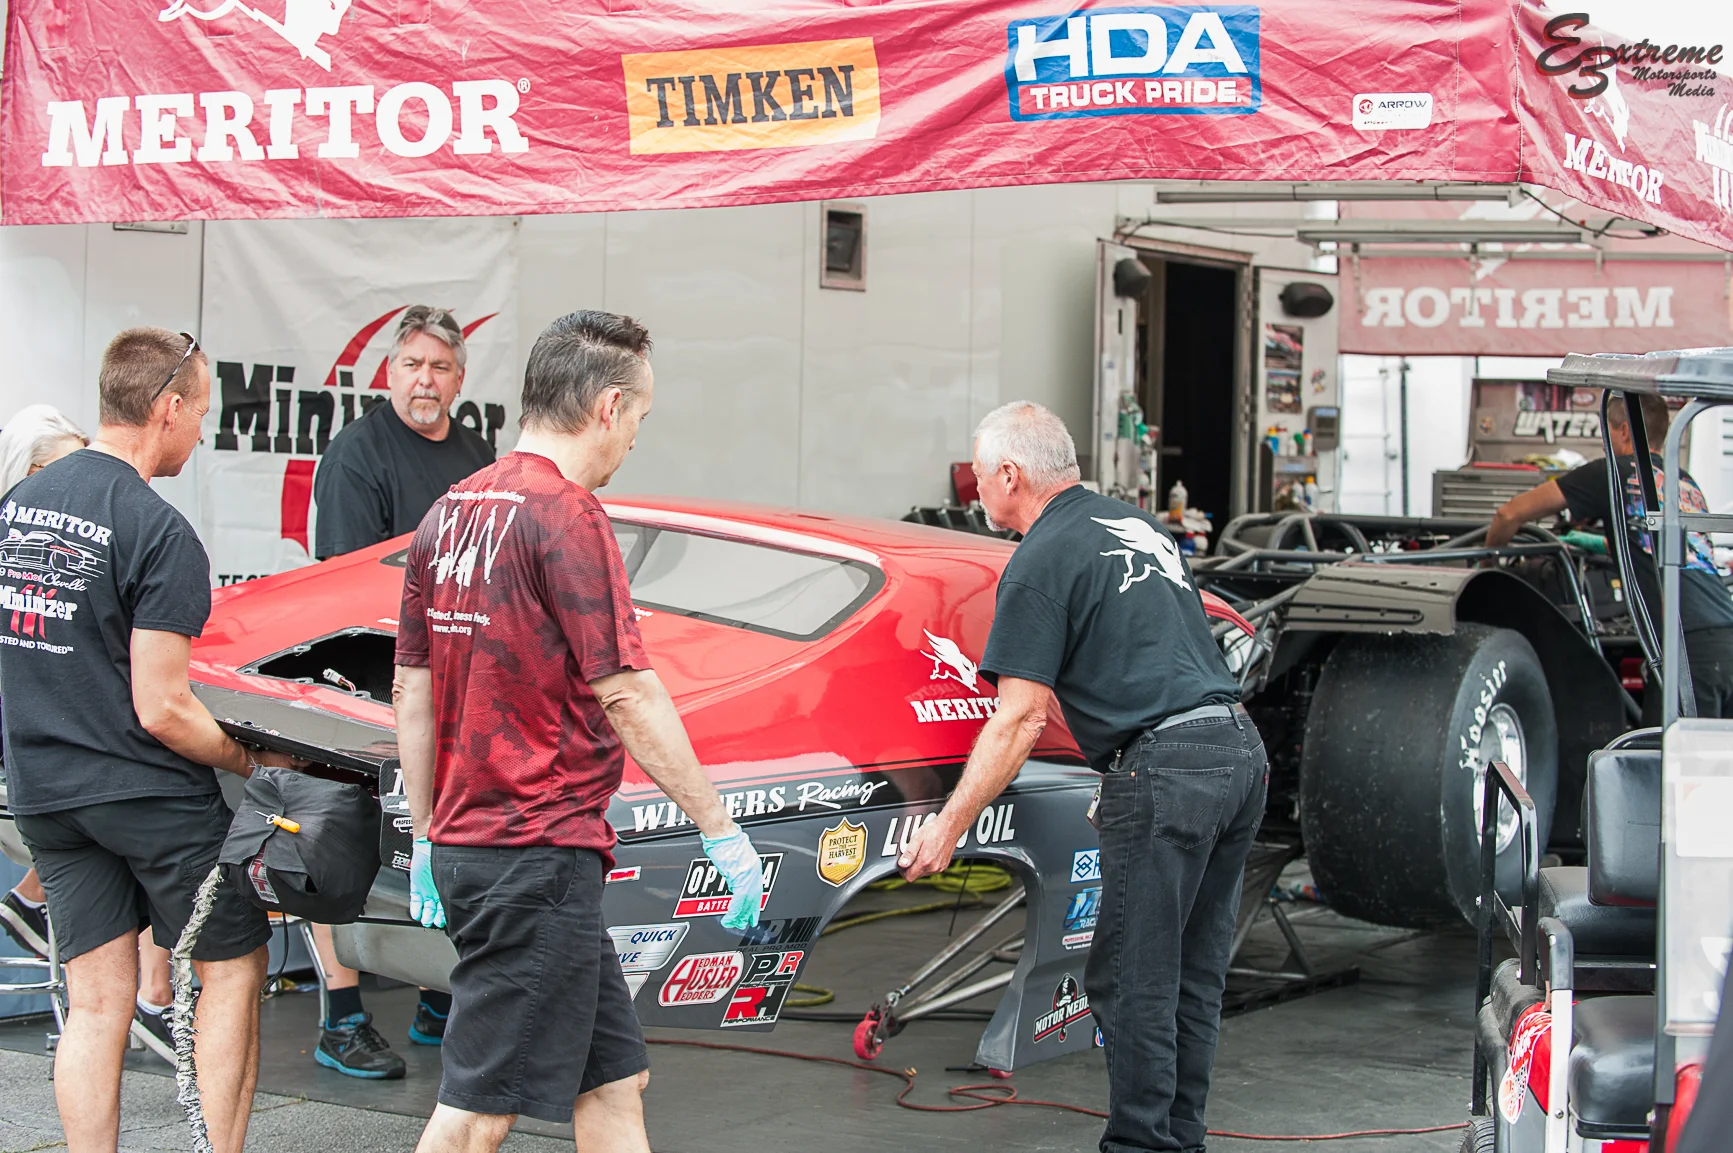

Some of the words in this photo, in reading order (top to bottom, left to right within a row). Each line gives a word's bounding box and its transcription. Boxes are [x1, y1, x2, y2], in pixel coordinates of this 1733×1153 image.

[1014, 12, 1248, 81] HDA
[646, 65, 855, 128] TIMKEN
[1030, 82, 1137, 109] TRUCK
[1378, 100, 1427, 109] ARROW
[214, 360, 505, 455] Minier
[14, 506, 112, 546] MERITOR
[7, 569, 22, 579] Pro
[43, 573, 87, 591] Chevelle
[0, 635, 19, 646] STED
[19, 639, 35, 649] AND
[910, 697, 1000, 723] MERIT
[631, 786, 786, 832] WIERS
[797, 779, 888, 811] Racing
[976, 803, 1016, 845] OIL
[829, 835, 857, 846] PROTECT
[829, 848, 857, 859] HARVEST
[697, 899, 730, 912] BATTE
[630, 929, 678, 944] QUICK
[723, 1015, 777, 1025] PERFORMANCE
[1034, 1007, 1065, 1036] MOTOR
[1065, 995, 1090, 1018] MEDI
